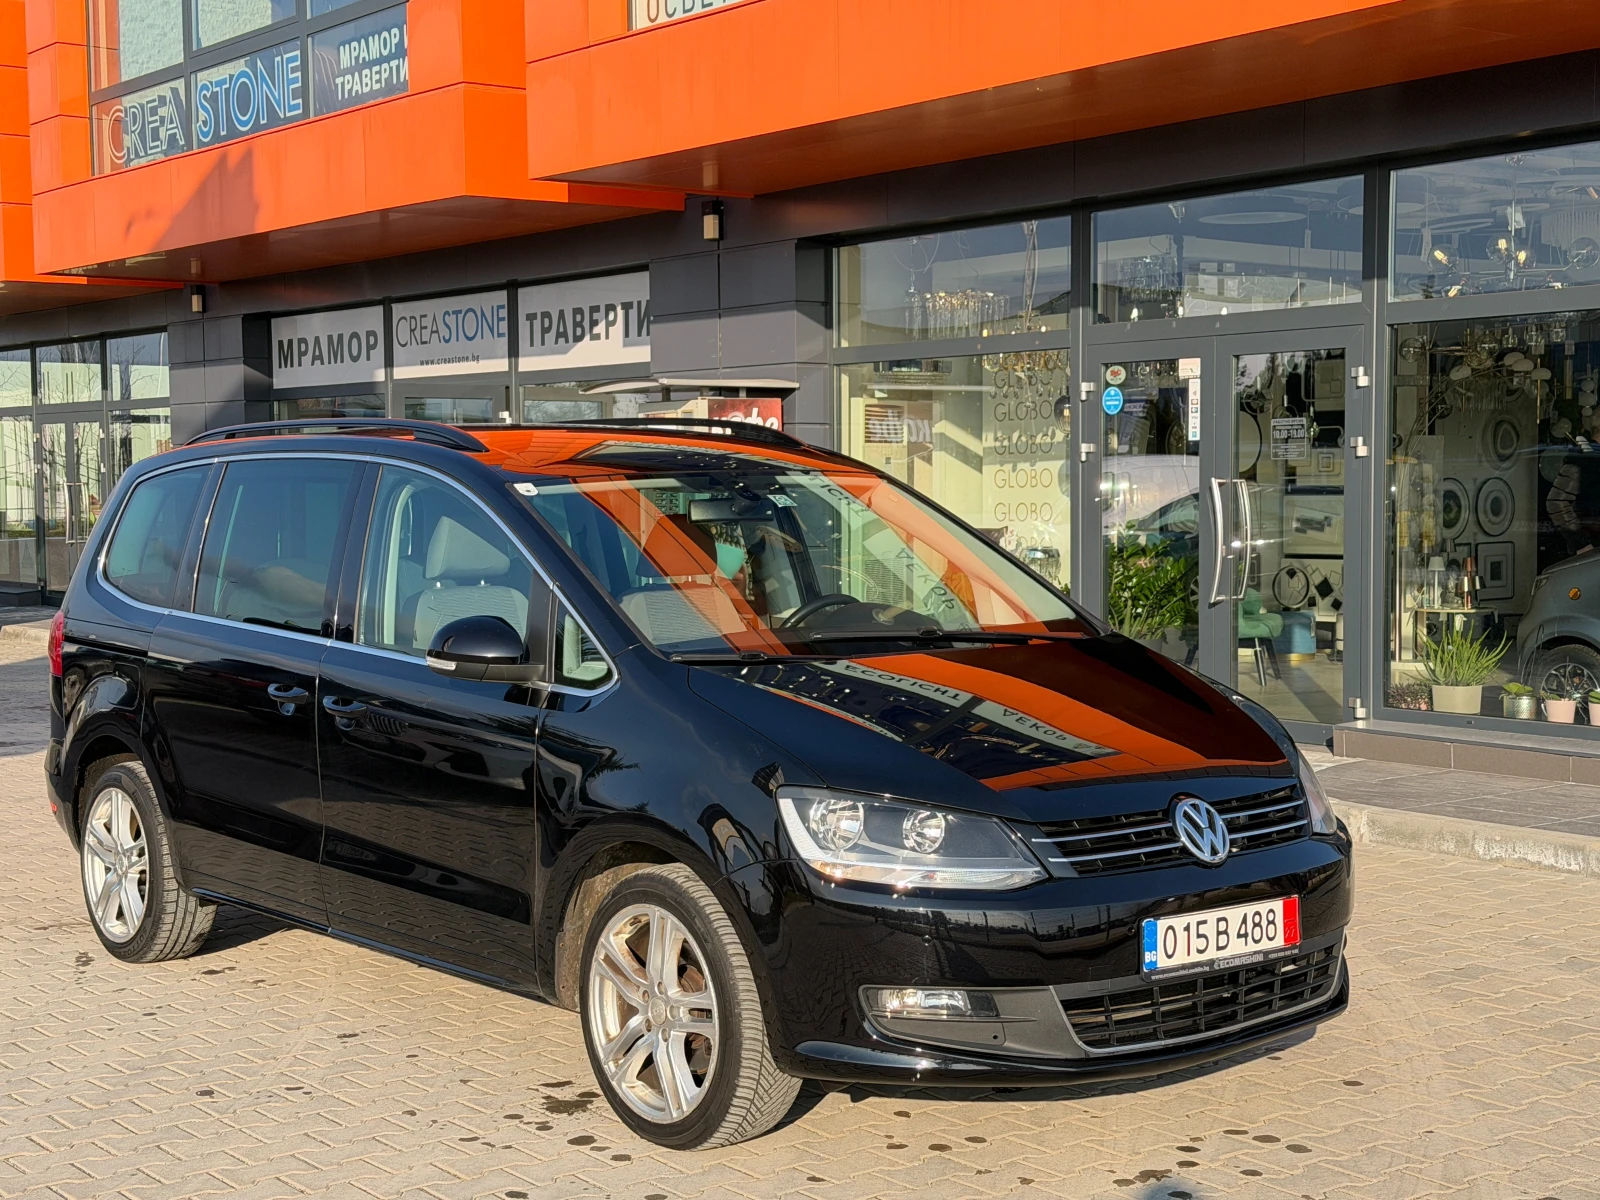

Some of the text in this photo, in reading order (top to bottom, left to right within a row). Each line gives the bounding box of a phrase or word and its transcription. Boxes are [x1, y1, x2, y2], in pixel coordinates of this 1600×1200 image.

[340, 27, 399, 69] МРАМОР
[335, 56, 408, 101] ТРАВЕРТИ
[107, 51, 303, 164] CREA STONE
[395, 304, 506, 347] CREASTONE
[525, 299, 650, 347] ТРАВЕРТИ
[277, 329, 378, 369] МРАМОР
[420, 353, 480, 366] www.creastone.bg
[994, 400, 1053, 422] GLOBO
[994, 434, 1053, 456] GLOBO
[994, 468, 1053, 489] GLOBO
[994, 502, 1053, 523] GLOBO
[1144, 951, 1157, 963] BG
